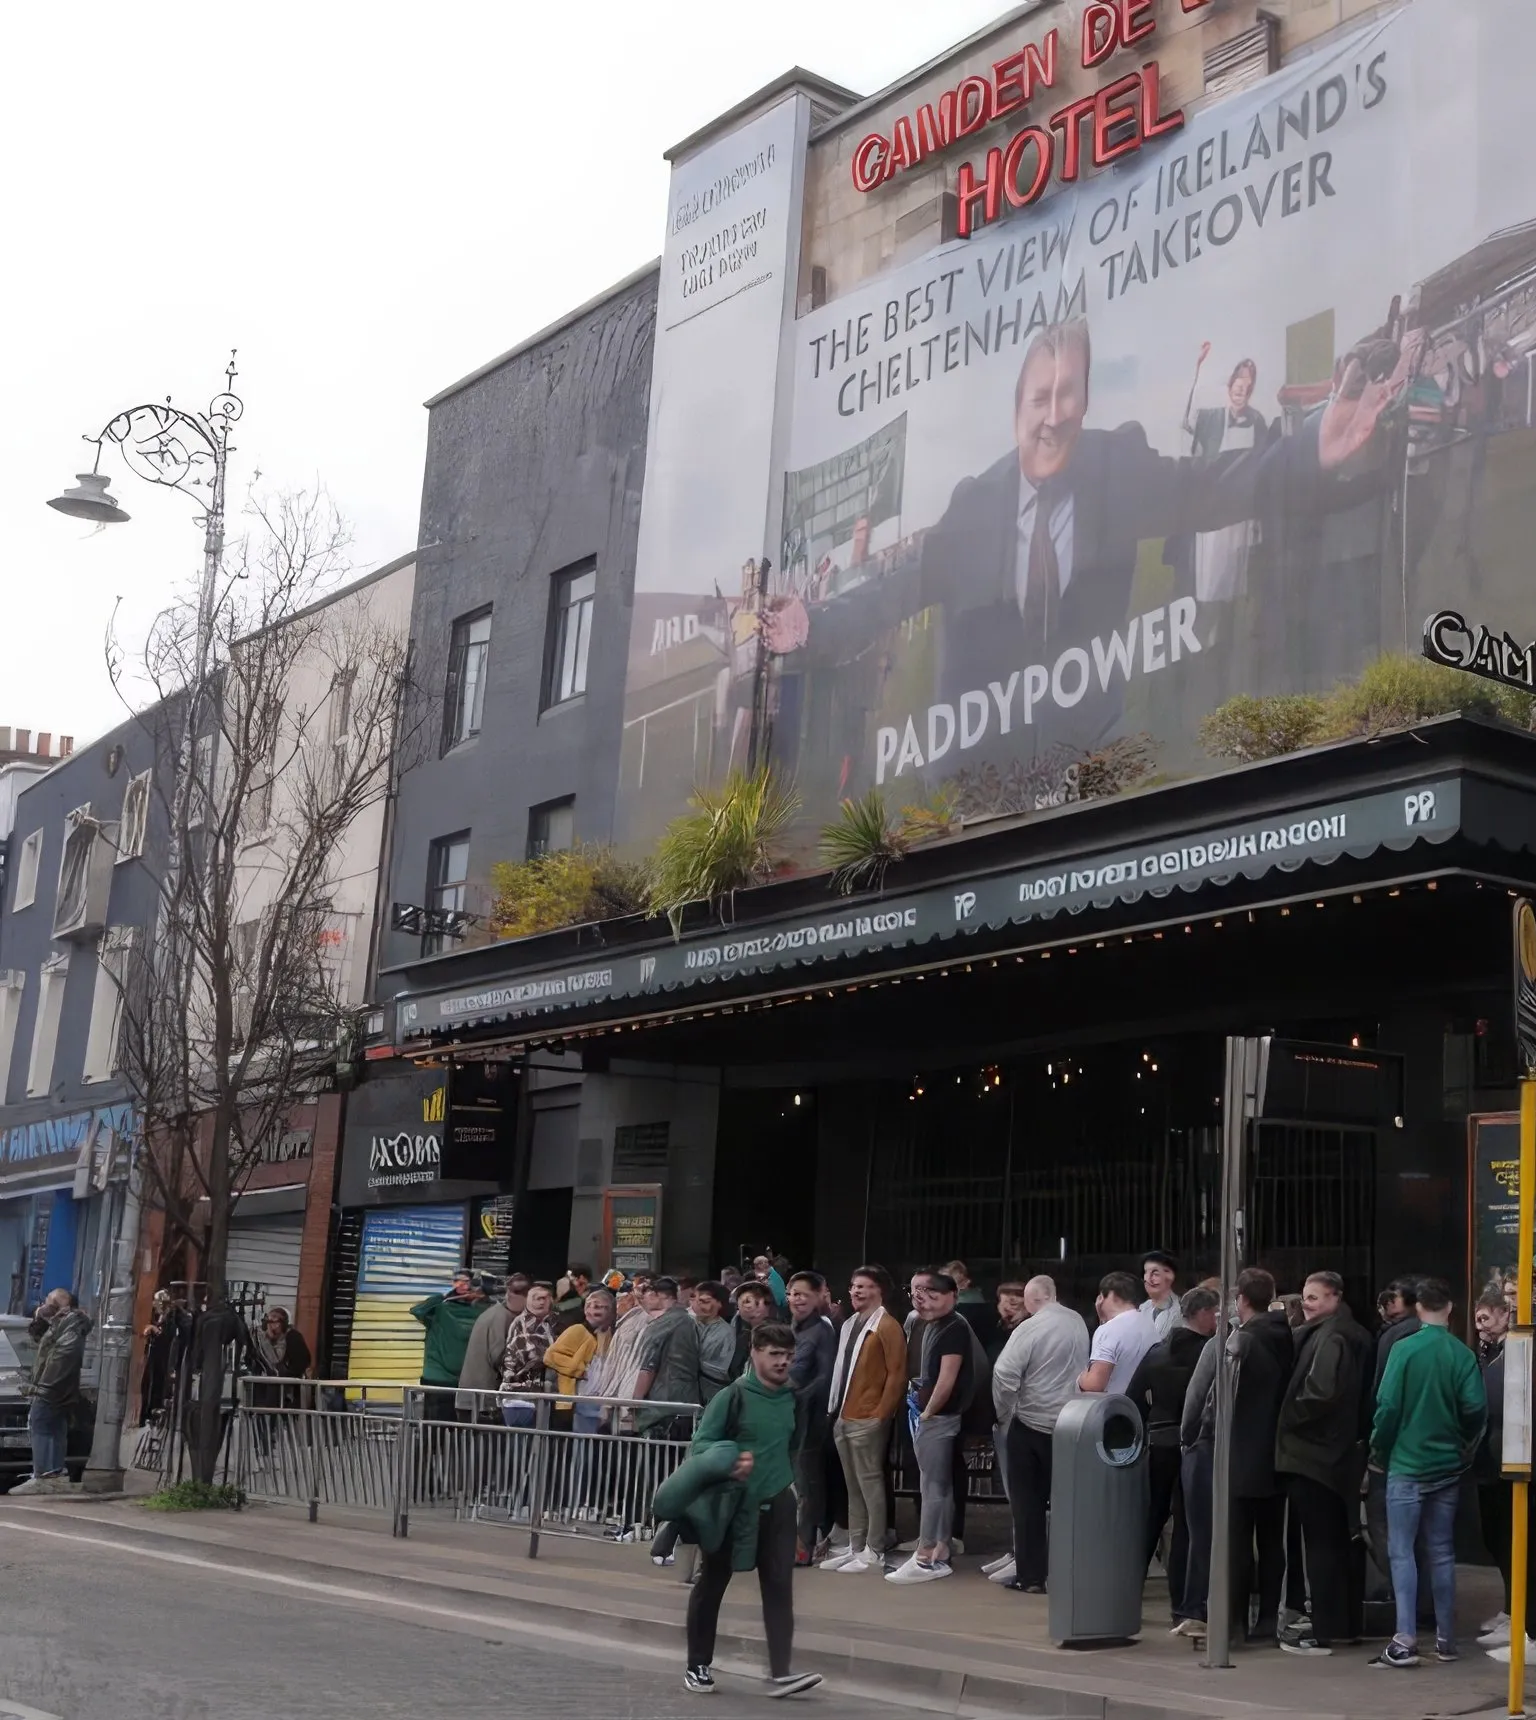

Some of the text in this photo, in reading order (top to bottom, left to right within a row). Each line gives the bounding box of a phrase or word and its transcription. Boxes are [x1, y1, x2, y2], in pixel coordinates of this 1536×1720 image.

[851, 28, 1058, 193] CAMDEN
[956, 60, 1185, 239] HOTEL
[809, 50, 1387, 379] THE BEST VIEW OF IRELAND'S
[837, 151, 1336, 417] CHELTENHAM TAKEOVER
[876, 596, 1202, 785] PADDYPOWER
